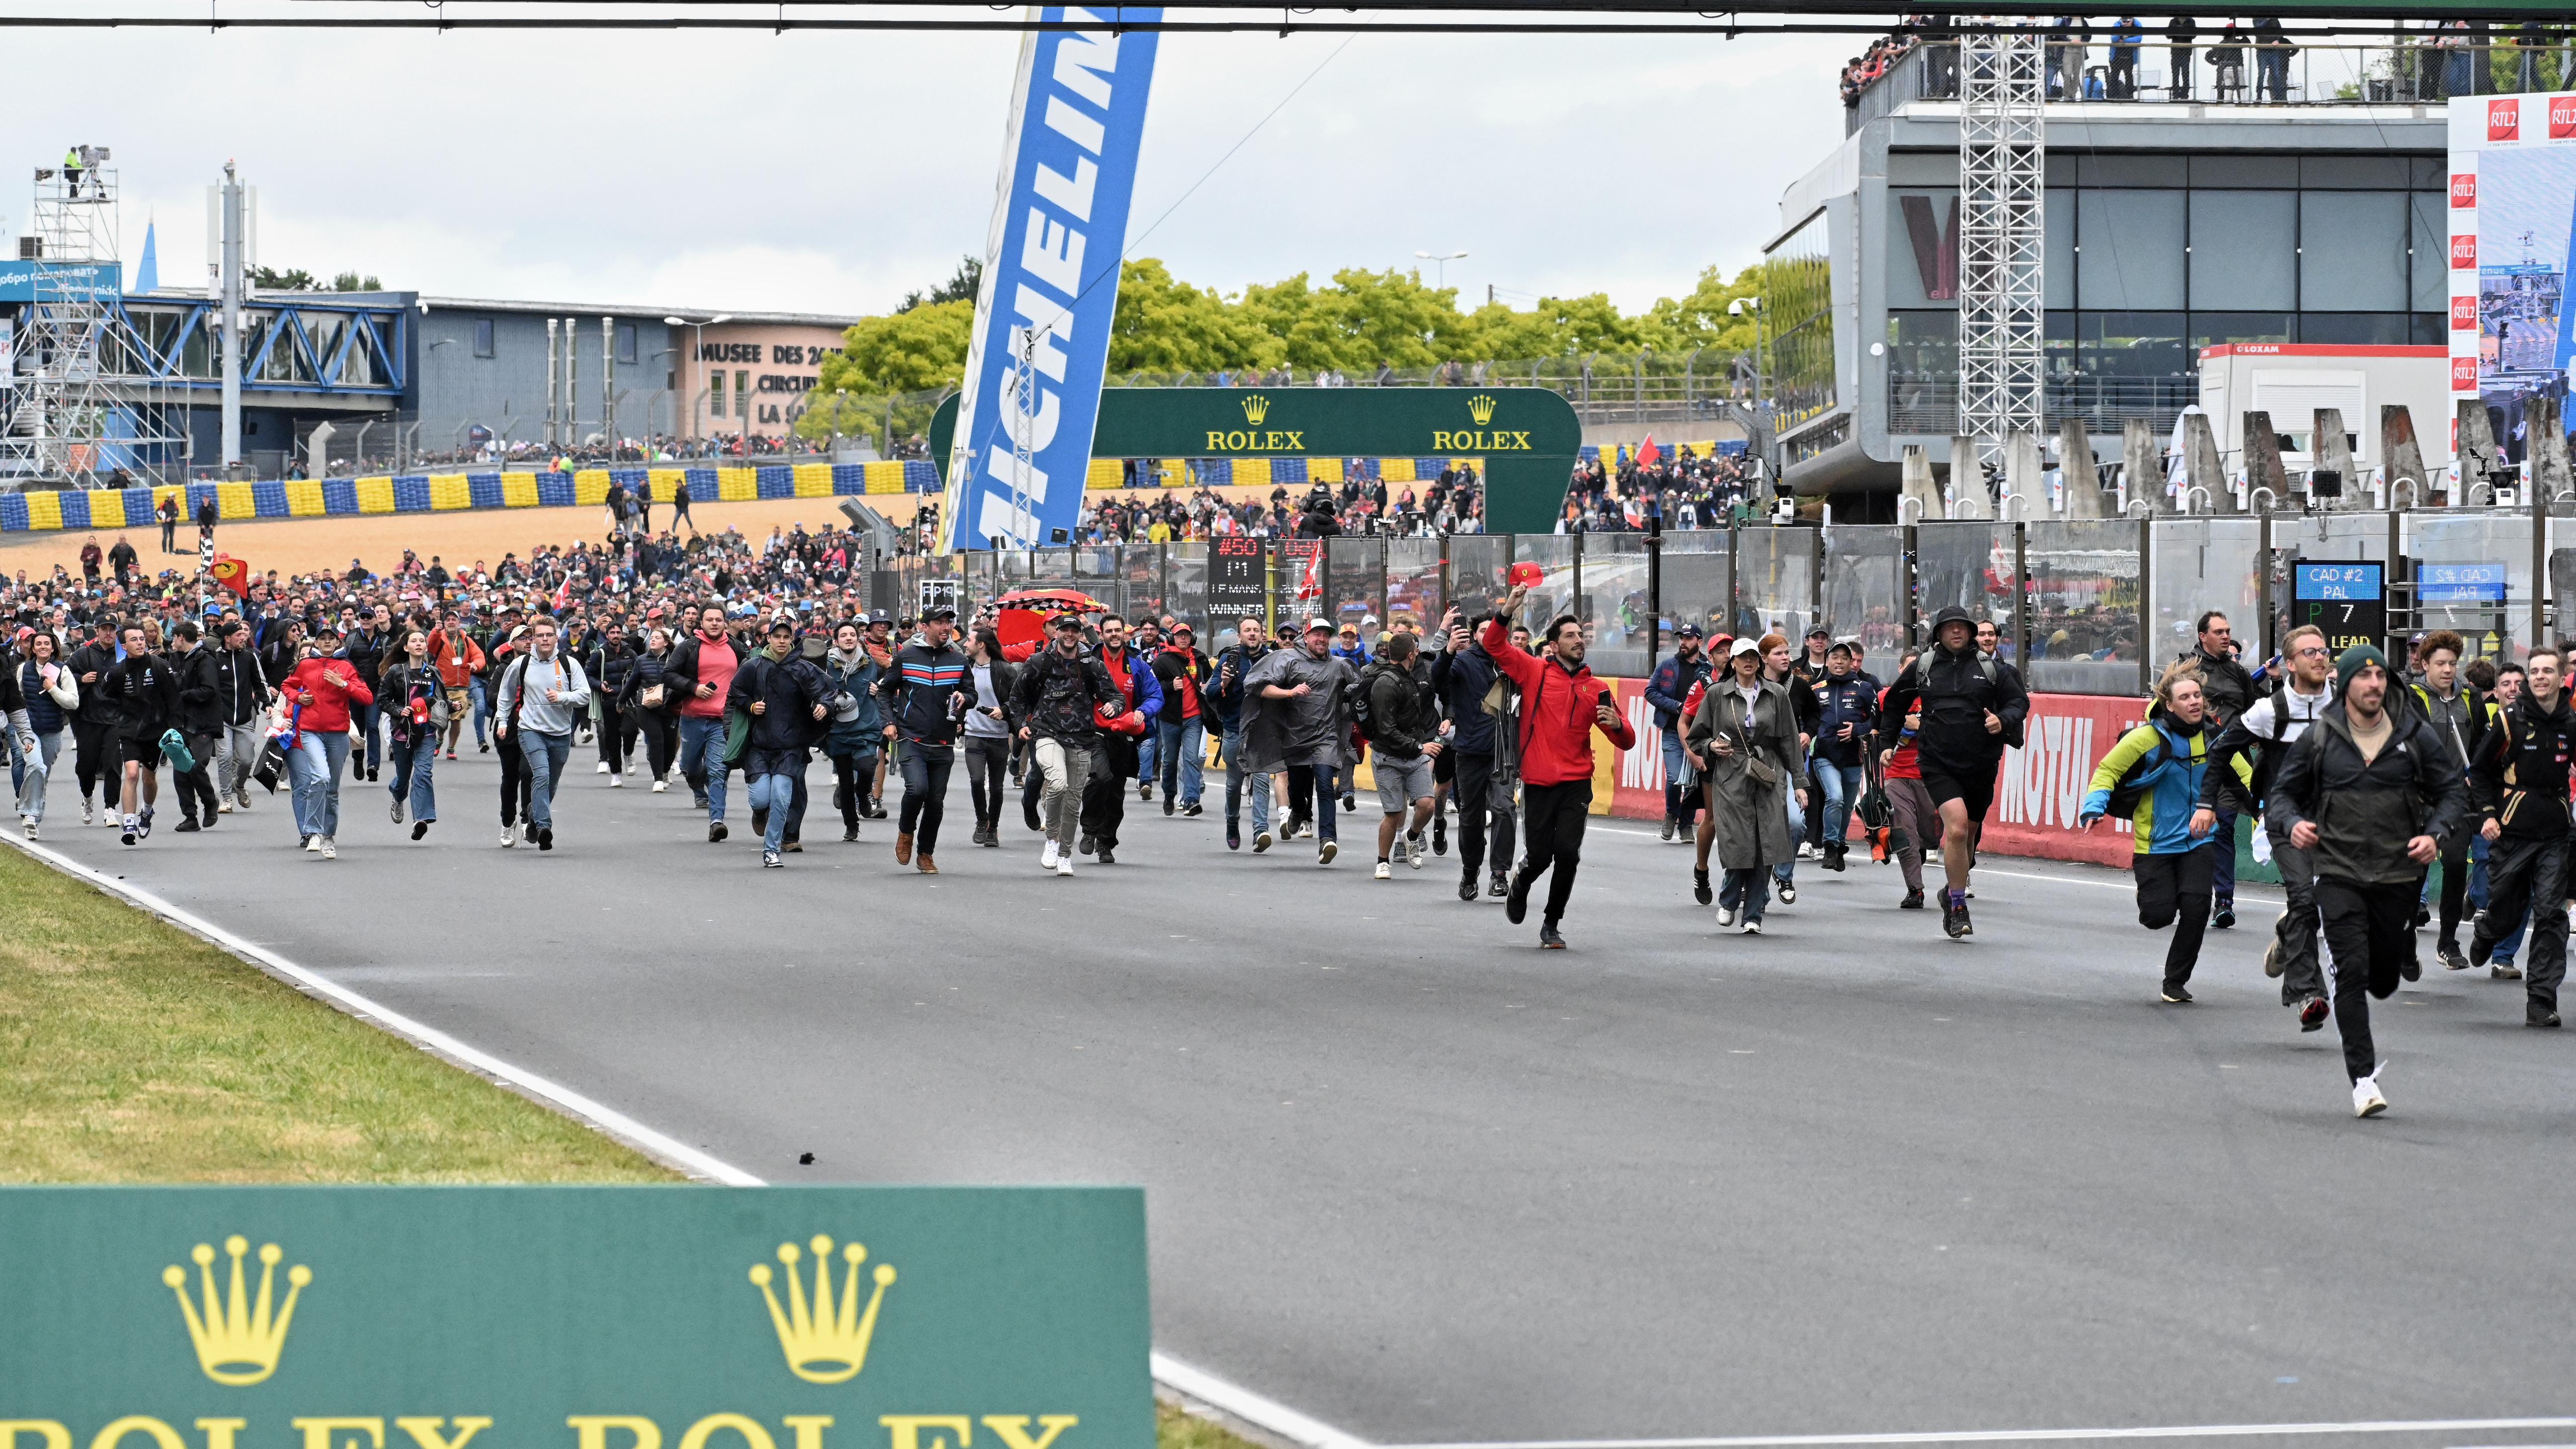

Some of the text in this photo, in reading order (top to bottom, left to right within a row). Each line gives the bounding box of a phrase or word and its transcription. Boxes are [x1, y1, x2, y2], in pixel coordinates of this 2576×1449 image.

[2491, 111, 2516, 127] RTL2
[2552, 109, 2576, 124] RTL2
[2453, 184, 2474, 197] RTL2
[2453, 245, 2474, 258] RTL2
[0, 272, 28, 285] обро
[2454, 306, 2475, 318] RTL2
[694, 344, 761, 363] MUSEE
[773, 346, 803, 364] DES
[2454, 366, 2475, 379] RTL2
[759, 405, 781, 424] LA
[1206, 431, 1305, 450] ROLEX
[1433, 431, 1532, 450] ROLEX
[1219, 538, 1257, 556] #50
[2310, 569, 2363, 582] CAD #2
[2323, 586, 2349, 599] PAL
[1209, 604, 1264, 614] WINNER
[2310, 603, 2354, 624] P 7
[2331, 636, 2370, 648] LEAD
